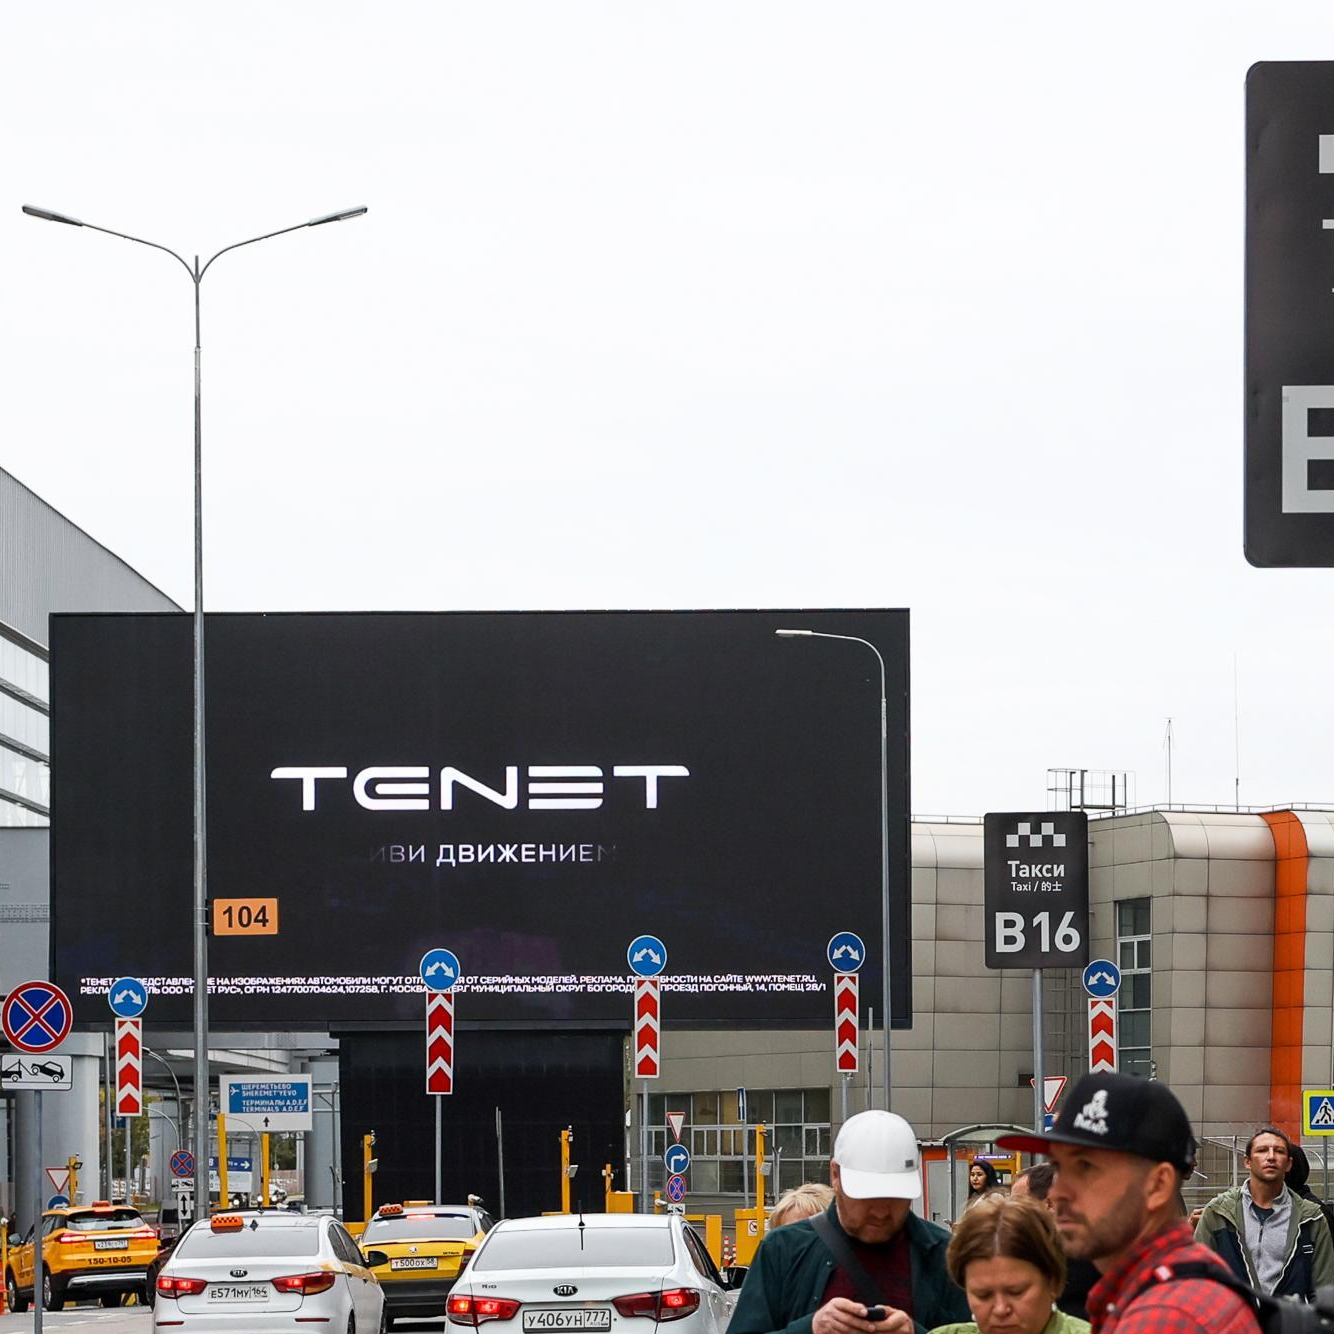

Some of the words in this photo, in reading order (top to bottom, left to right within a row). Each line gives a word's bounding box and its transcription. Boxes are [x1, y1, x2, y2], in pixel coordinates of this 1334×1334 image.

[270, 765, 690, 811] TENET
[1008, 860, 1065, 878] Такси
[1011, 881, 1032, 892] Taxi
[222, 904, 270, 929] 104
[217, 977, 231, 986] НА
[231, 977, 306, 986] ИЗОБРАЖЕНИЯХ
[307, 976, 371, 985] АВТОМОБИЛИ
[372, 976, 404, 985] МОГУТ
[466, 975, 479, 984] ОТ
[480, 974, 530, 984] СЕРИЙНЫХ
[699, 975, 710, 983] НА
[711, 974, 743, 983] САЙТЕ
[161, 986, 183, 995] ООО
[244, 986, 269, 994] ОГРН
[471, 983, 555, 994] МУНИЦИПАЛЬНЫЙ
[555, 984, 585, 993] ОКРУГ
[699, 983, 754, 993] ПОГОННЫЙ,
[87, 1255, 133, 1265] 150-10-05
[556, 1286, 574, 1294] KIA
[585, 1311, 606, 1322] 777
